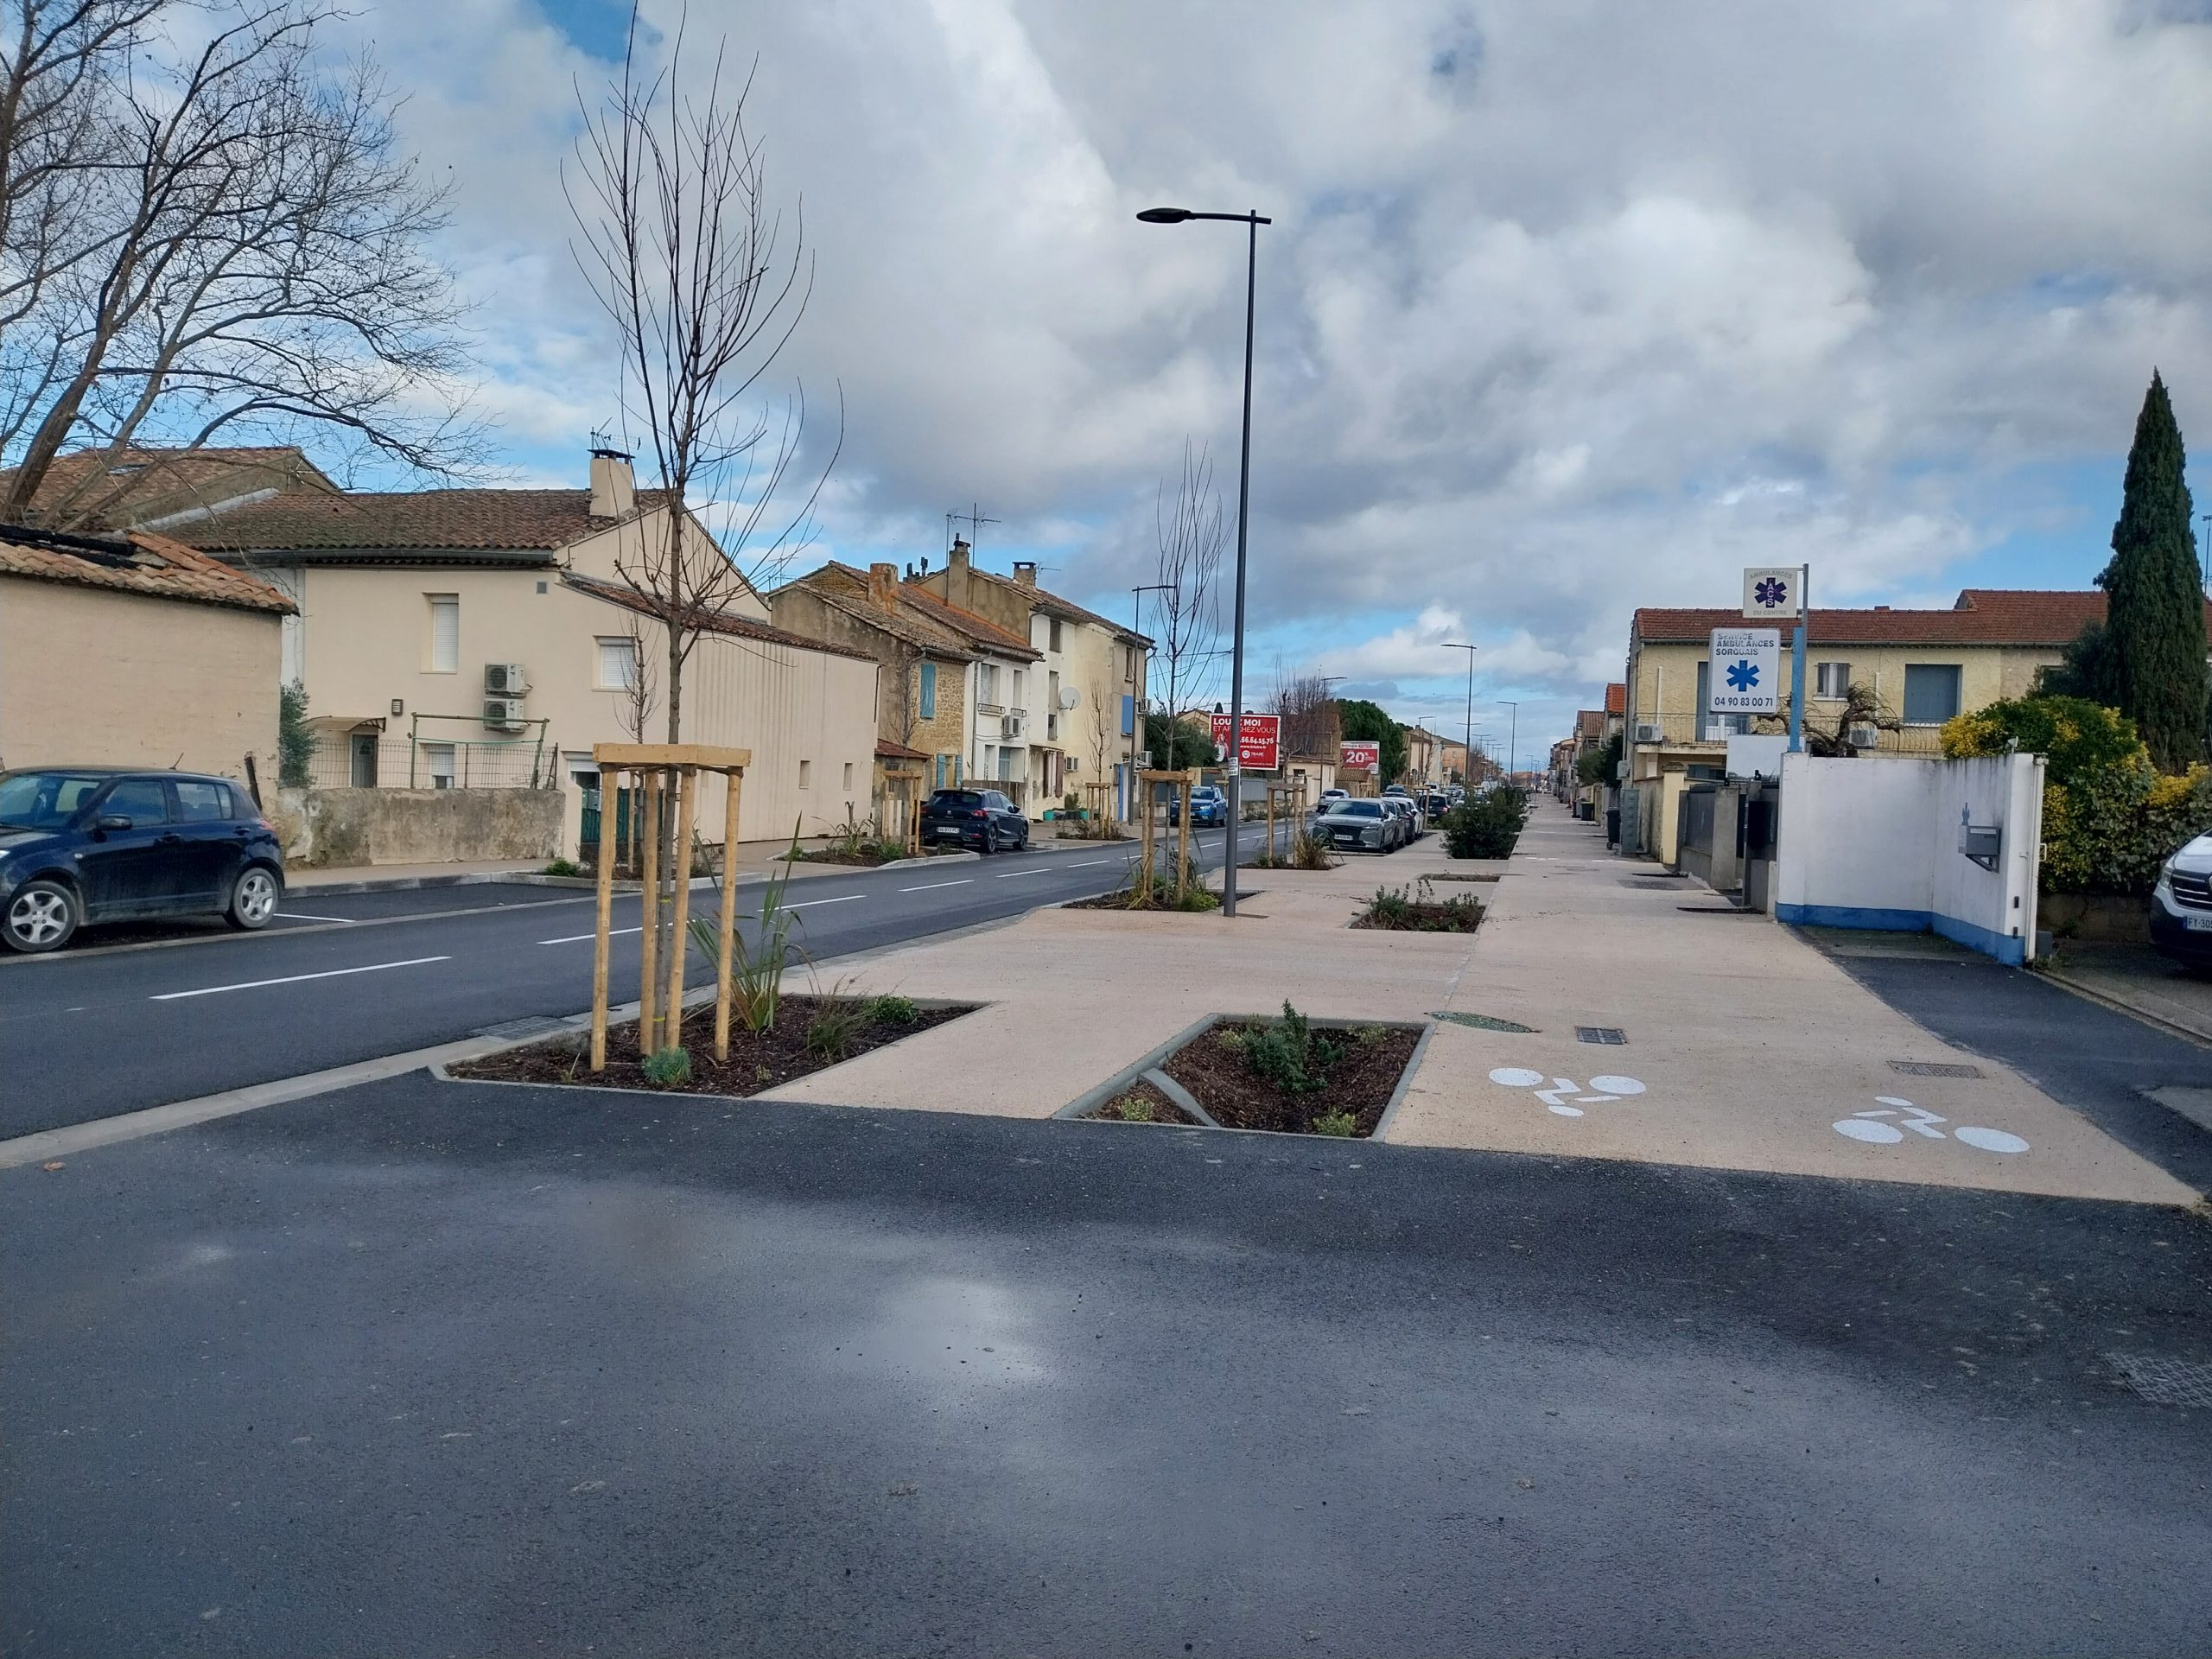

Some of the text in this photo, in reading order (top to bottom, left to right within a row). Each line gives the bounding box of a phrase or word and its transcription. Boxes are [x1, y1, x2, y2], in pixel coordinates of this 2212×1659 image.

[1714, 696, 1773, 707] 04 90 83 00 71
